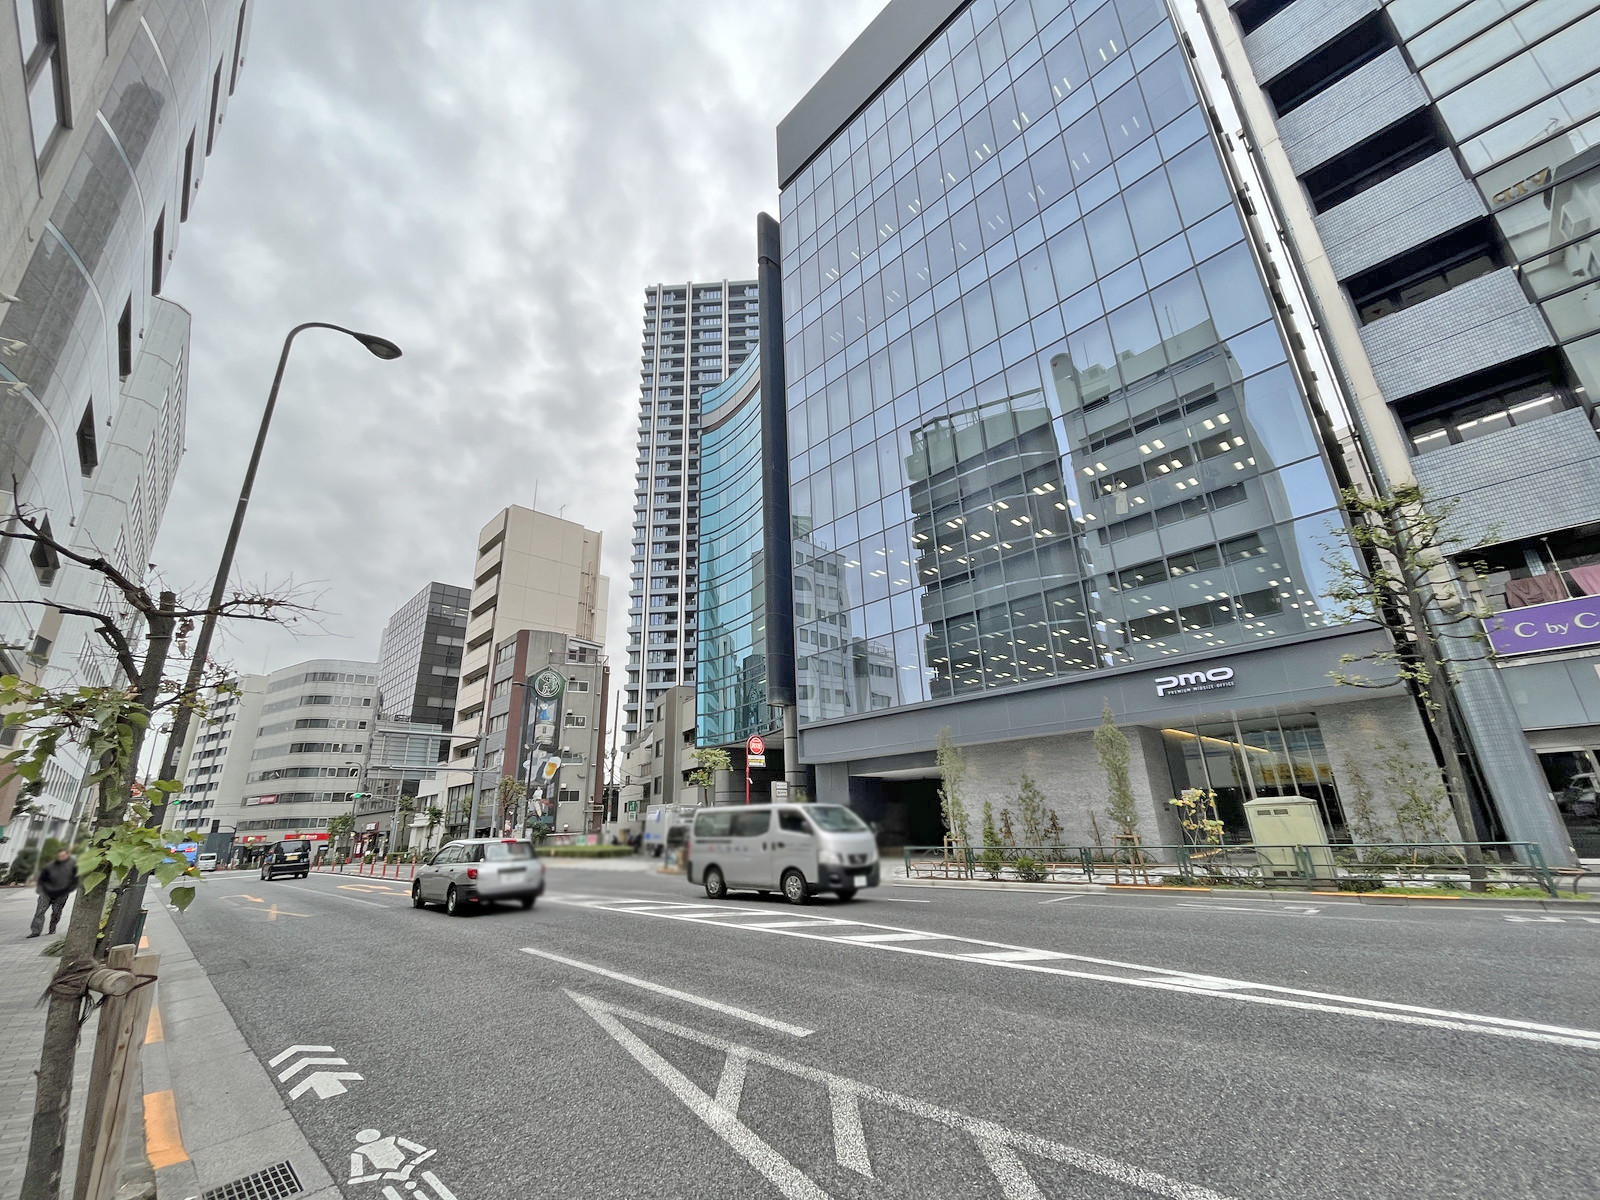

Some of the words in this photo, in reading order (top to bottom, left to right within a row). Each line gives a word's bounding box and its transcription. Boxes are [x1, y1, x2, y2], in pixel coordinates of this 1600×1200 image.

[1514, 622, 1538, 638] C
[1545, 622, 1569, 635] by
[1574, 612, 1600, 629] C
[1168, 687, 1192, 695] PREMIUM
[1193, 683, 1215, 691] MIDSIZE
